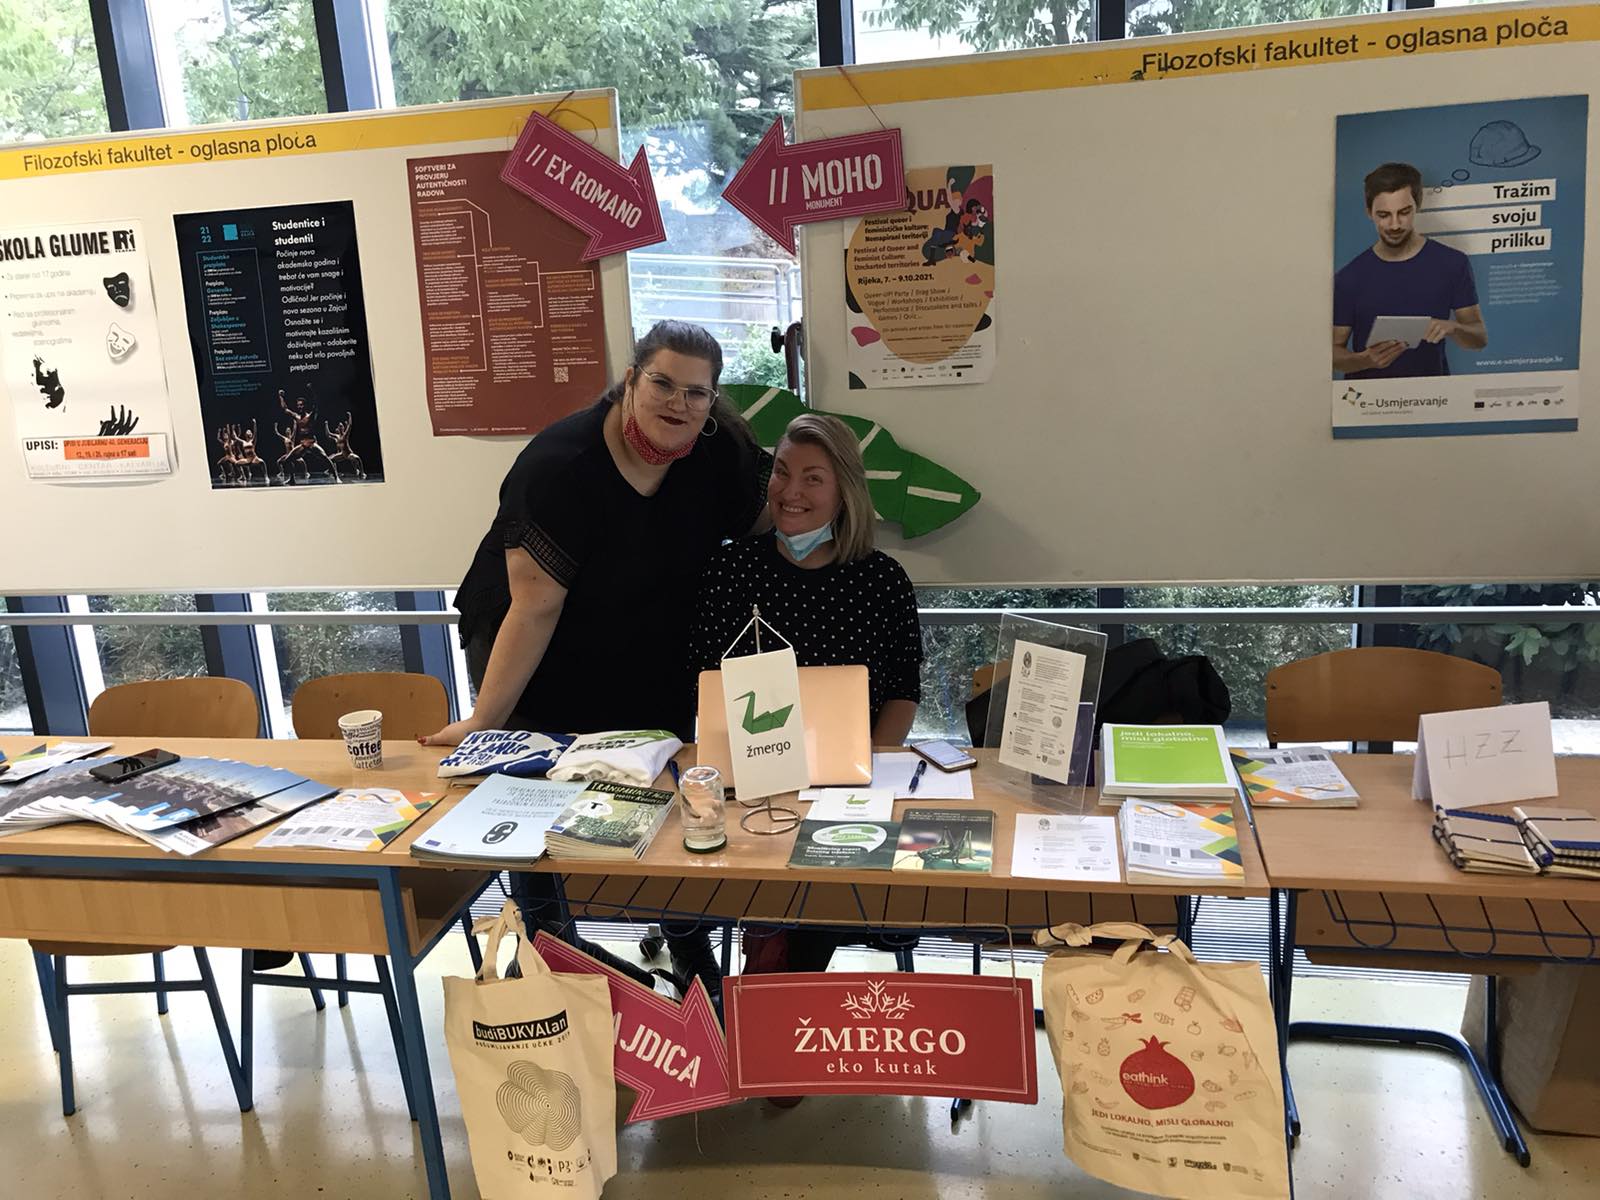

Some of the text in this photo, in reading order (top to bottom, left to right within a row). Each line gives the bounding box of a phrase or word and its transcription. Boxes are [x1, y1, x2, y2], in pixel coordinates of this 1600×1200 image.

[1143, 44, 1257, 75] Filozofski
[1265, 33, 1358, 62] fakultet
[1386, 22, 1487, 53] oglasna
[1497, 16, 1568, 45] ploča
[24, 153, 103, 173] Filozofski
[107, 145, 173, 164] fakultet
[190, 138, 261, 160] oglasna
[414, 164, 447, 174] SOFTVERI
[415, 173, 449, 181] PROVJERU
[802, 154, 883, 200] MOHO
[416, 178, 468, 190] AUTENTIČNOSTI
[1493, 182, 1551, 199] Tražim
[416, 189, 445, 197] RADOVA
[544, 154, 573, 185] EX
[570, 171, 643, 229] ROMANO
[806, 197, 843, 210] MONUMENT
[272, 216, 325, 231] Studentice i
[864, 217, 889, 226] Festival
[890, 217, 908, 226] queer
[1492, 208, 1537, 226] svoju
[200, 226, 210, 234] 21
[50, 231, 110, 258] GLUME
[201, 235, 212, 243] 22
[274, 233, 314, 246] studenti!
[1491, 232, 1545, 253] priliku
[276, 249, 299, 258] Počinje
[854, 246, 879, 254] Festival
[887, 244, 907, 253] Queer
[854, 254, 880, 262] Feminist
[854, 261, 920, 271] Uncharted territories
[857, 277, 884, 286] Rijeka,
[898, 273, 935, 283] 9.10.2021.
[300, 306, 322, 314] sezona
[288, 352, 304, 360] neku
[304, 351, 313, 359] od
[26, 440, 59, 451] UPISI:
[463, 732, 533, 745] WORLD
[746, 739, 792, 759] žmergo
[1442, 729, 1526, 769] HZZ
[794, 1016, 967, 1056] ŽMERGO
[532, 1040, 553, 1048] UČKE
[826, 1058, 937, 1075] eko kutak
[1122, 1071, 1169, 1085] eathink
[1091, 1108, 1234, 1128] JEDI LOKALNO, MISLI GLOBALNO!
